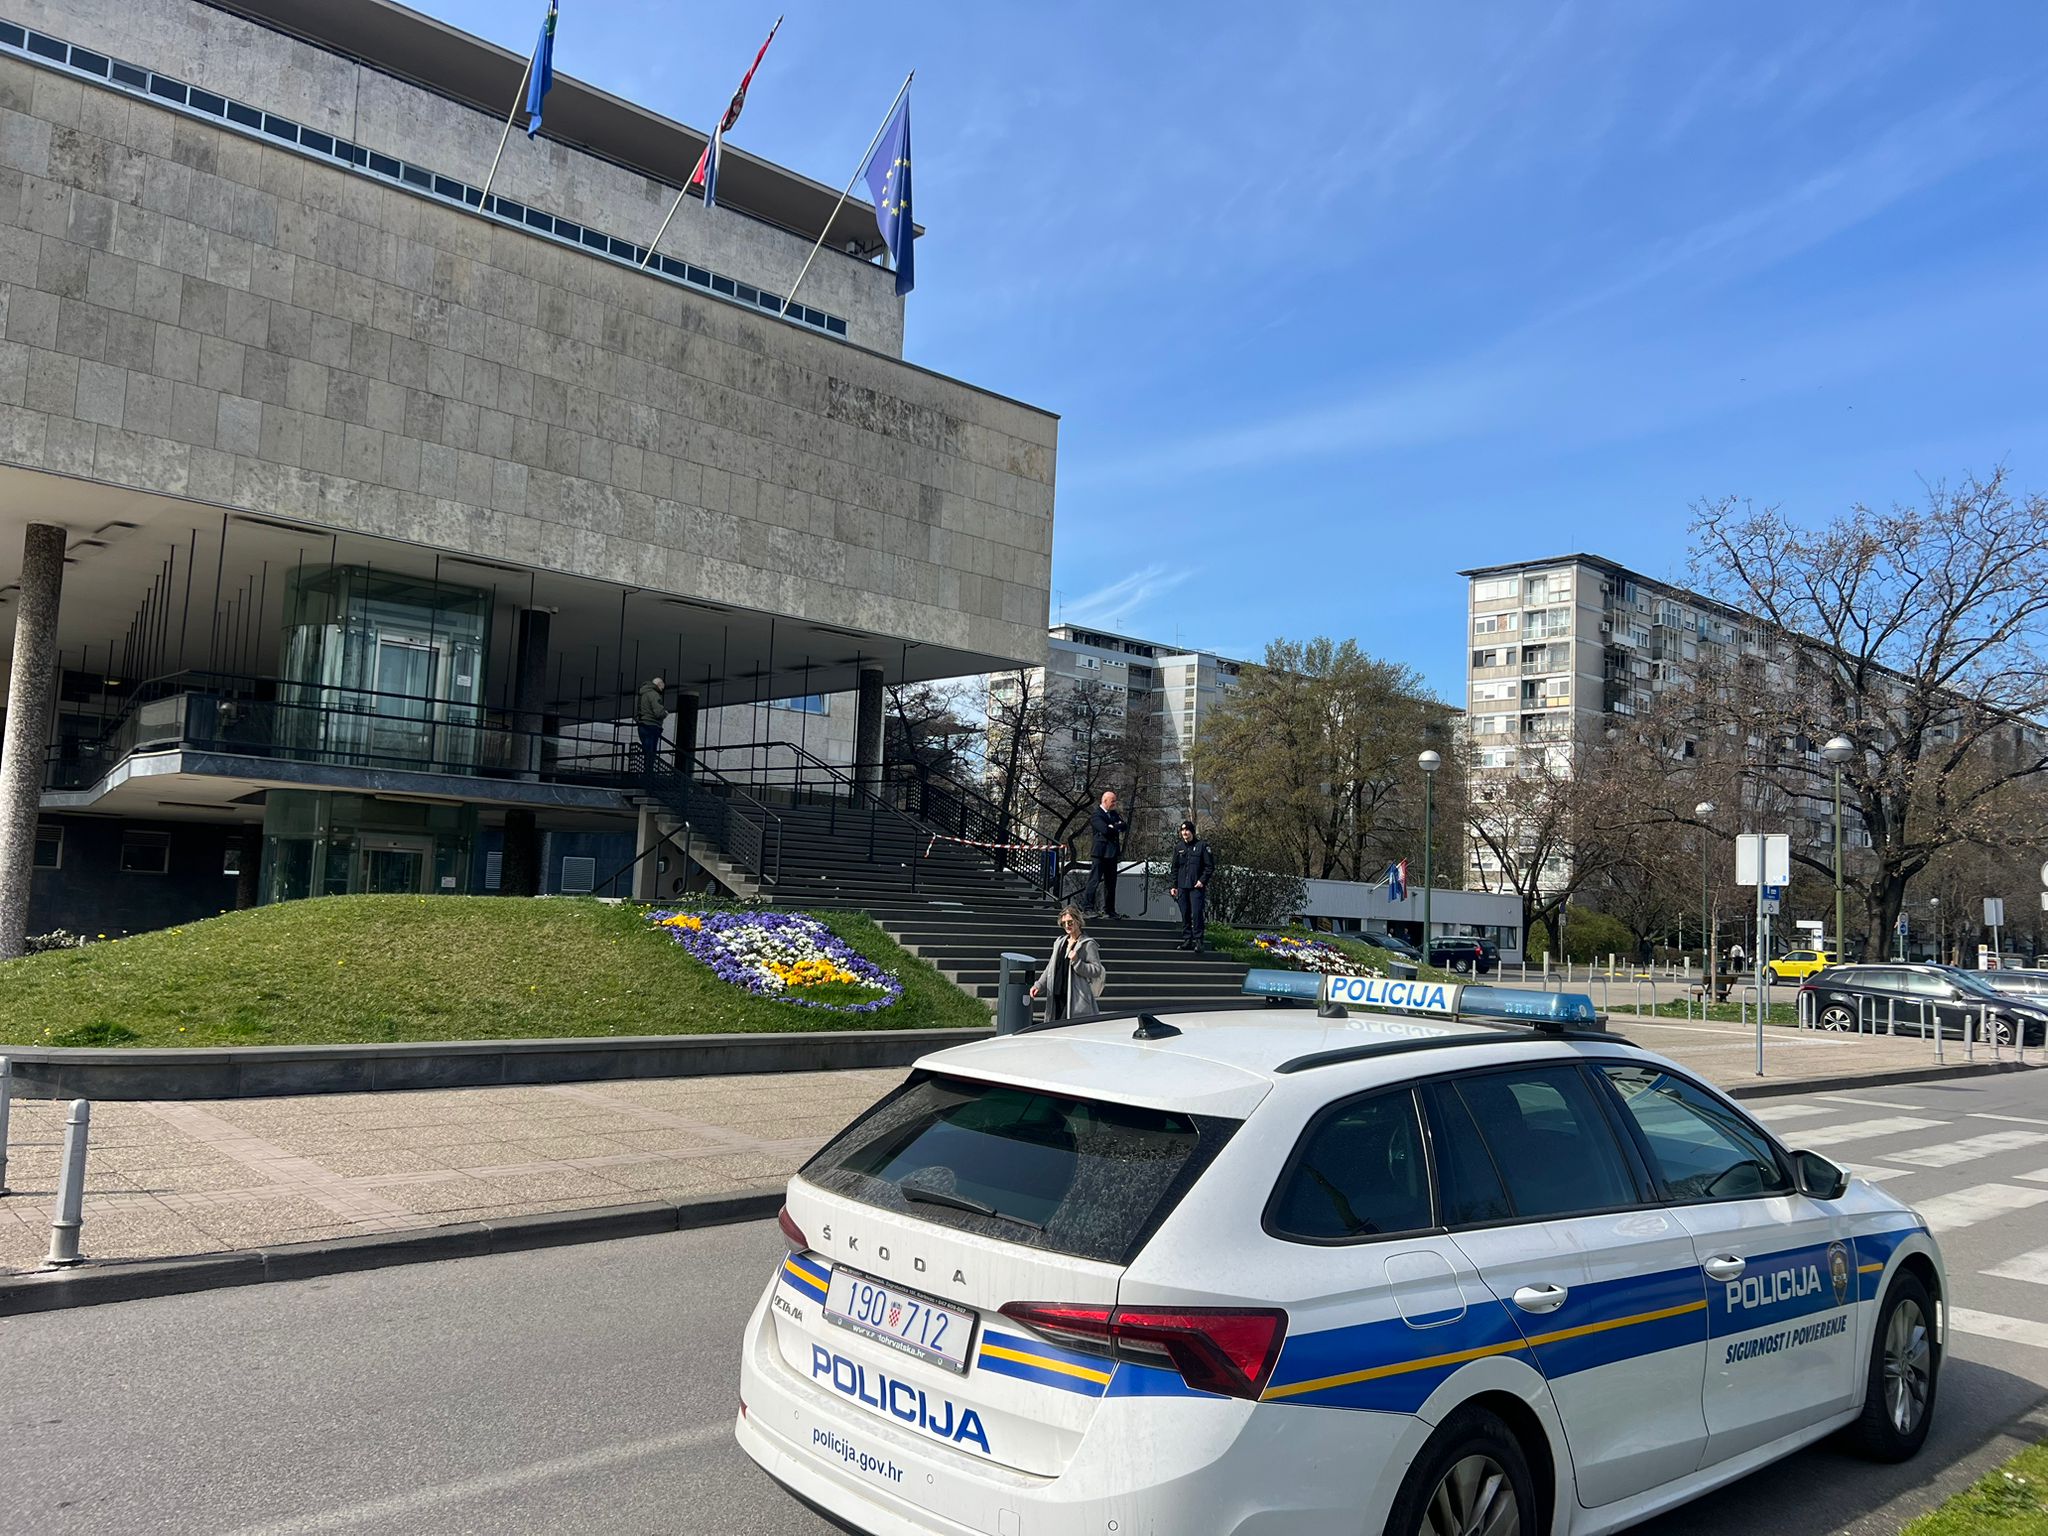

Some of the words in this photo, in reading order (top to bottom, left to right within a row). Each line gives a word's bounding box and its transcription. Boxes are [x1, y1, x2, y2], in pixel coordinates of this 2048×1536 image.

[1331, 977, 1446, 1010] POLICIJA
[823, 1224, 967, 1286] ŠKODA
[1726, 1264, 1822, 1313] POLICIJA
[848, 1282, 887, 1326] 190
[901, 1301, 949, 1352] 712
[1725, 1332, 1786, 1364] SIGURNOST
[1786, 1330, 1792, 1349] I
[1791, 1315, 1848, 1348] POVJERENJE
[812, 1343, 991, 1455] POLICIJA
[813, 1427, 904, 1482] policija.gov.hr
